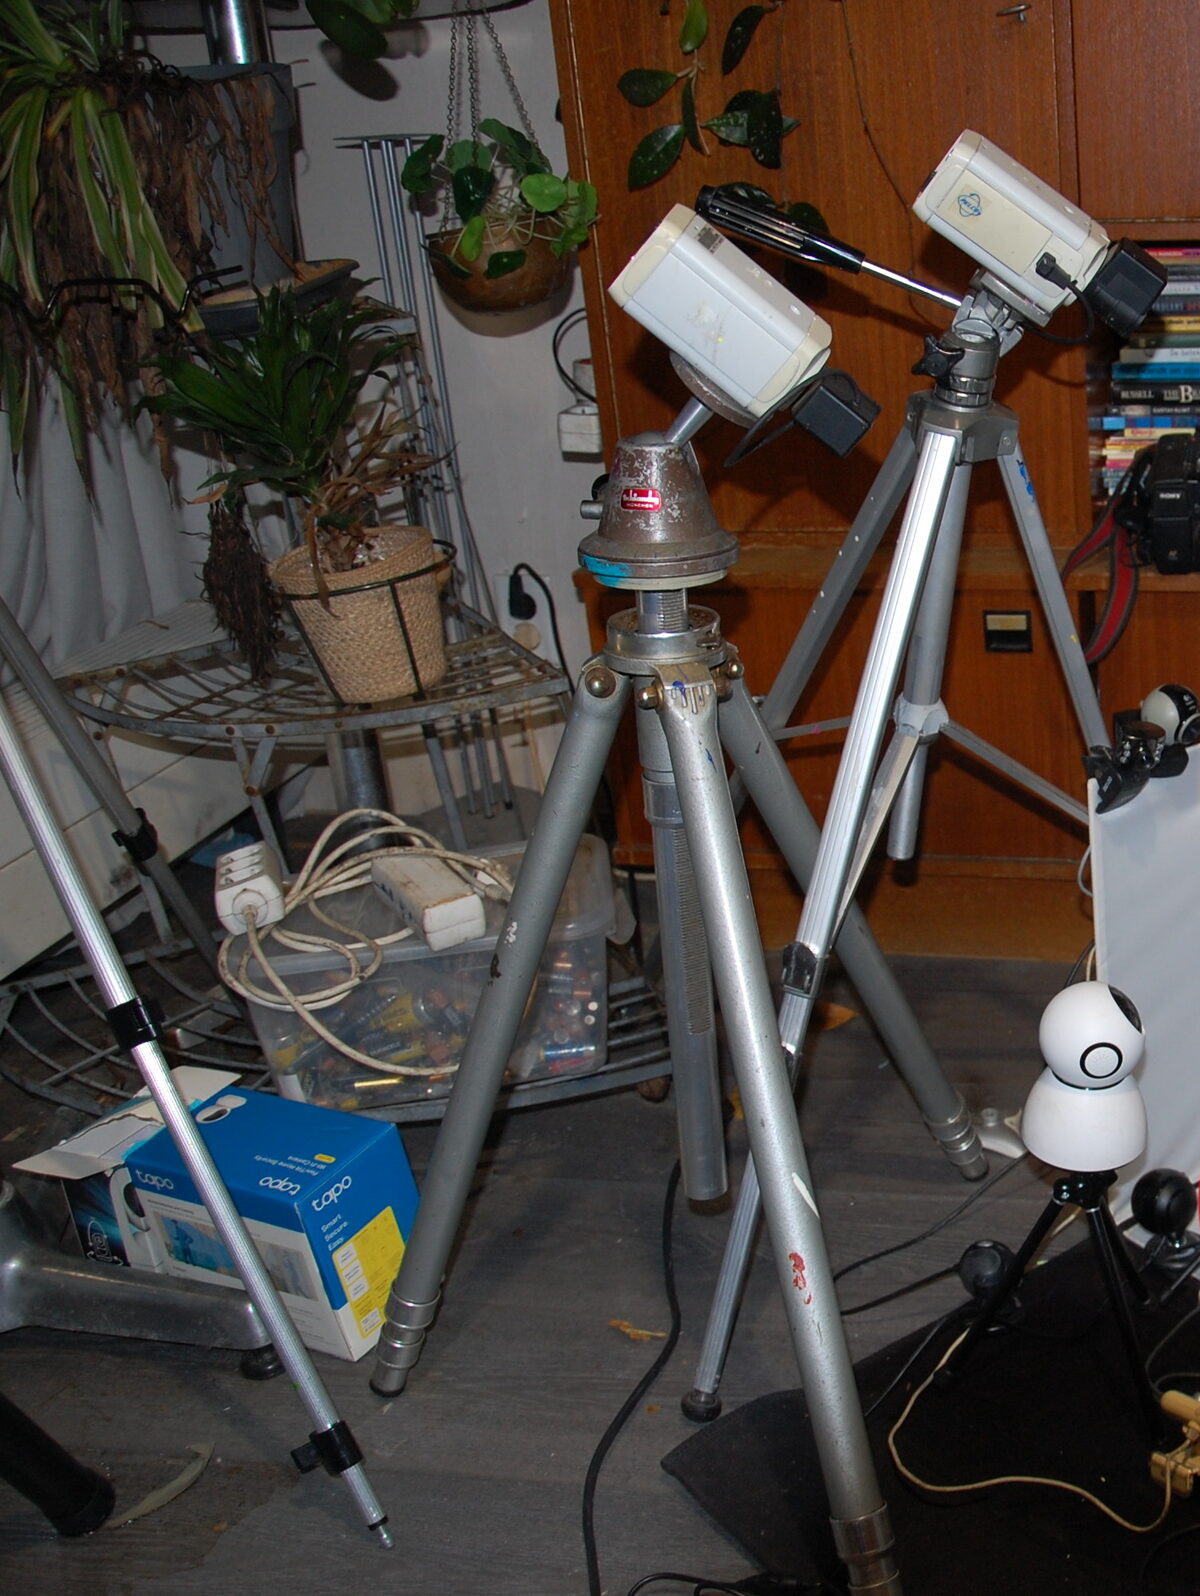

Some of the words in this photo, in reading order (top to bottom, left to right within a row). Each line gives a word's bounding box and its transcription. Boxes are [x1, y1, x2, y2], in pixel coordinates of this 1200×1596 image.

[1120, 389, 1155, 399] RUSSELL
[1162, 389, 1180, 401] THE
[135, 1169, 174, 1191] tapo
[258, 1176, 301, 1196] tapo
[311, 1175, 352, 1212] tapo
[321, 1213, 342, 1233] Smart
